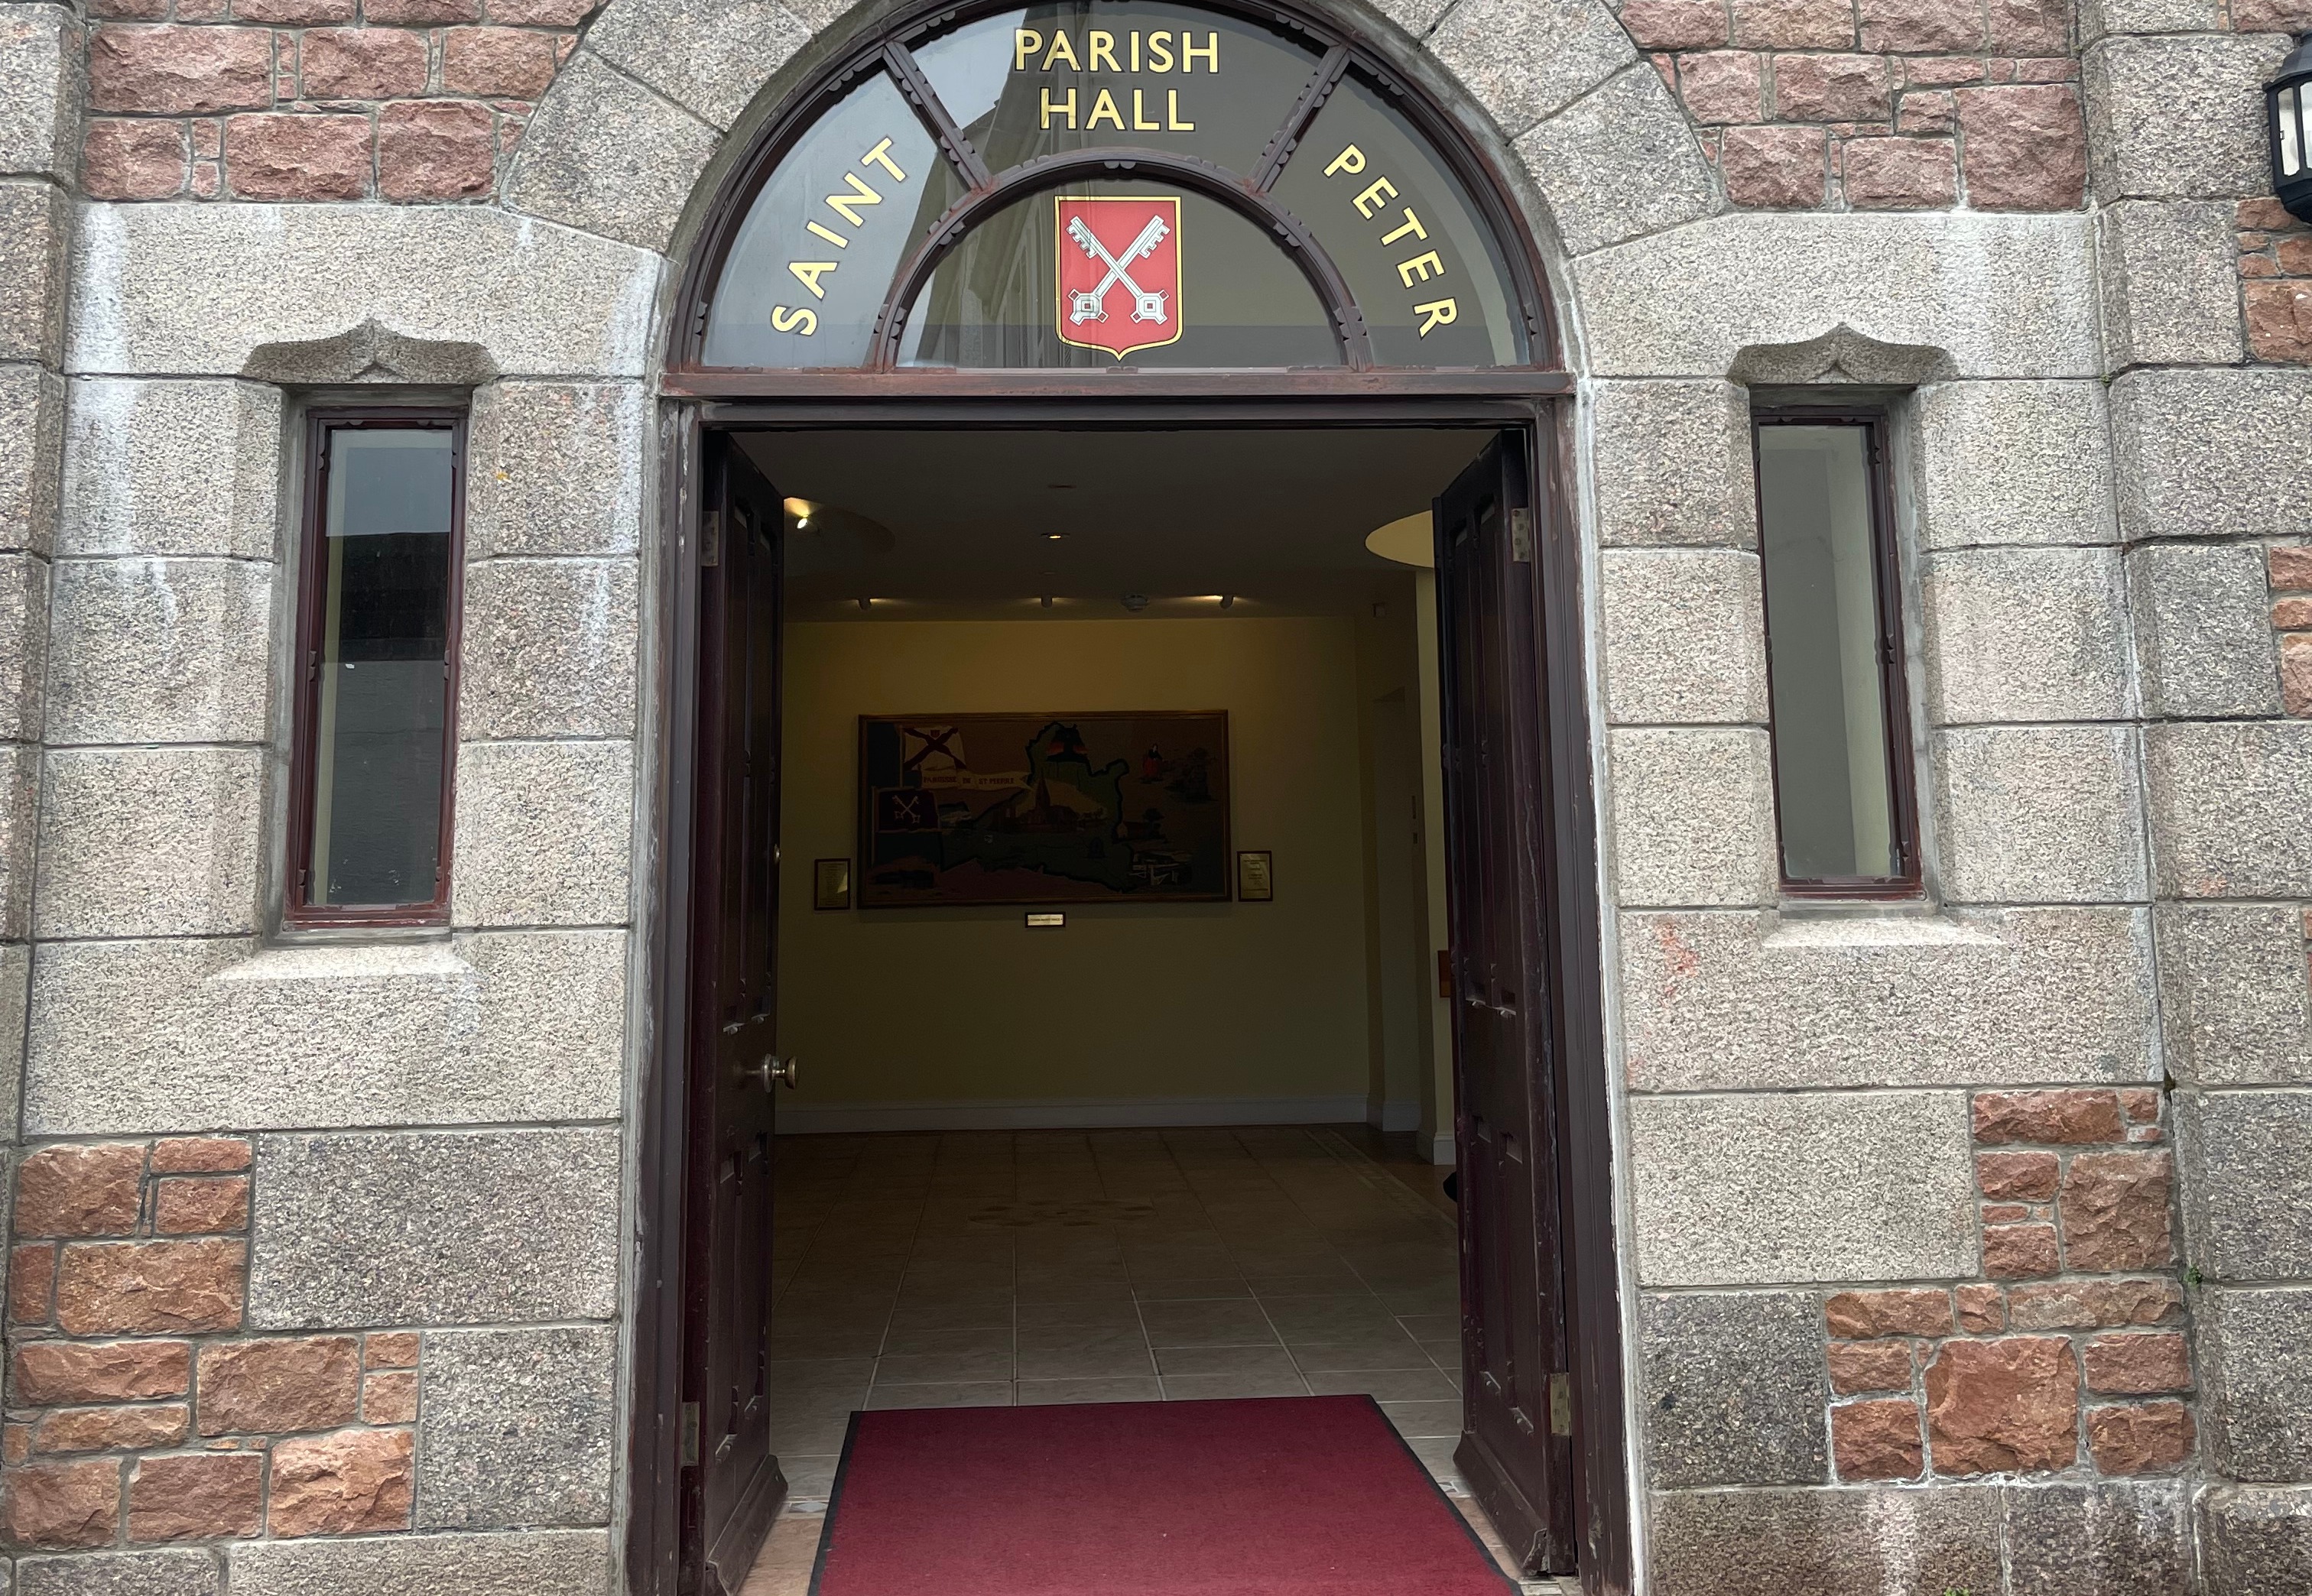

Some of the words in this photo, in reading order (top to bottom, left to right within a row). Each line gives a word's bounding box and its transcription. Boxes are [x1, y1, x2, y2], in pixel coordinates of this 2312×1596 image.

[1015, 29, 1219, 73] PARISH
[1040, 87, 1195, 131] HALL
[771, 136, 908, 337] SAINT
[1323, 143, 1458, 339] PETER
